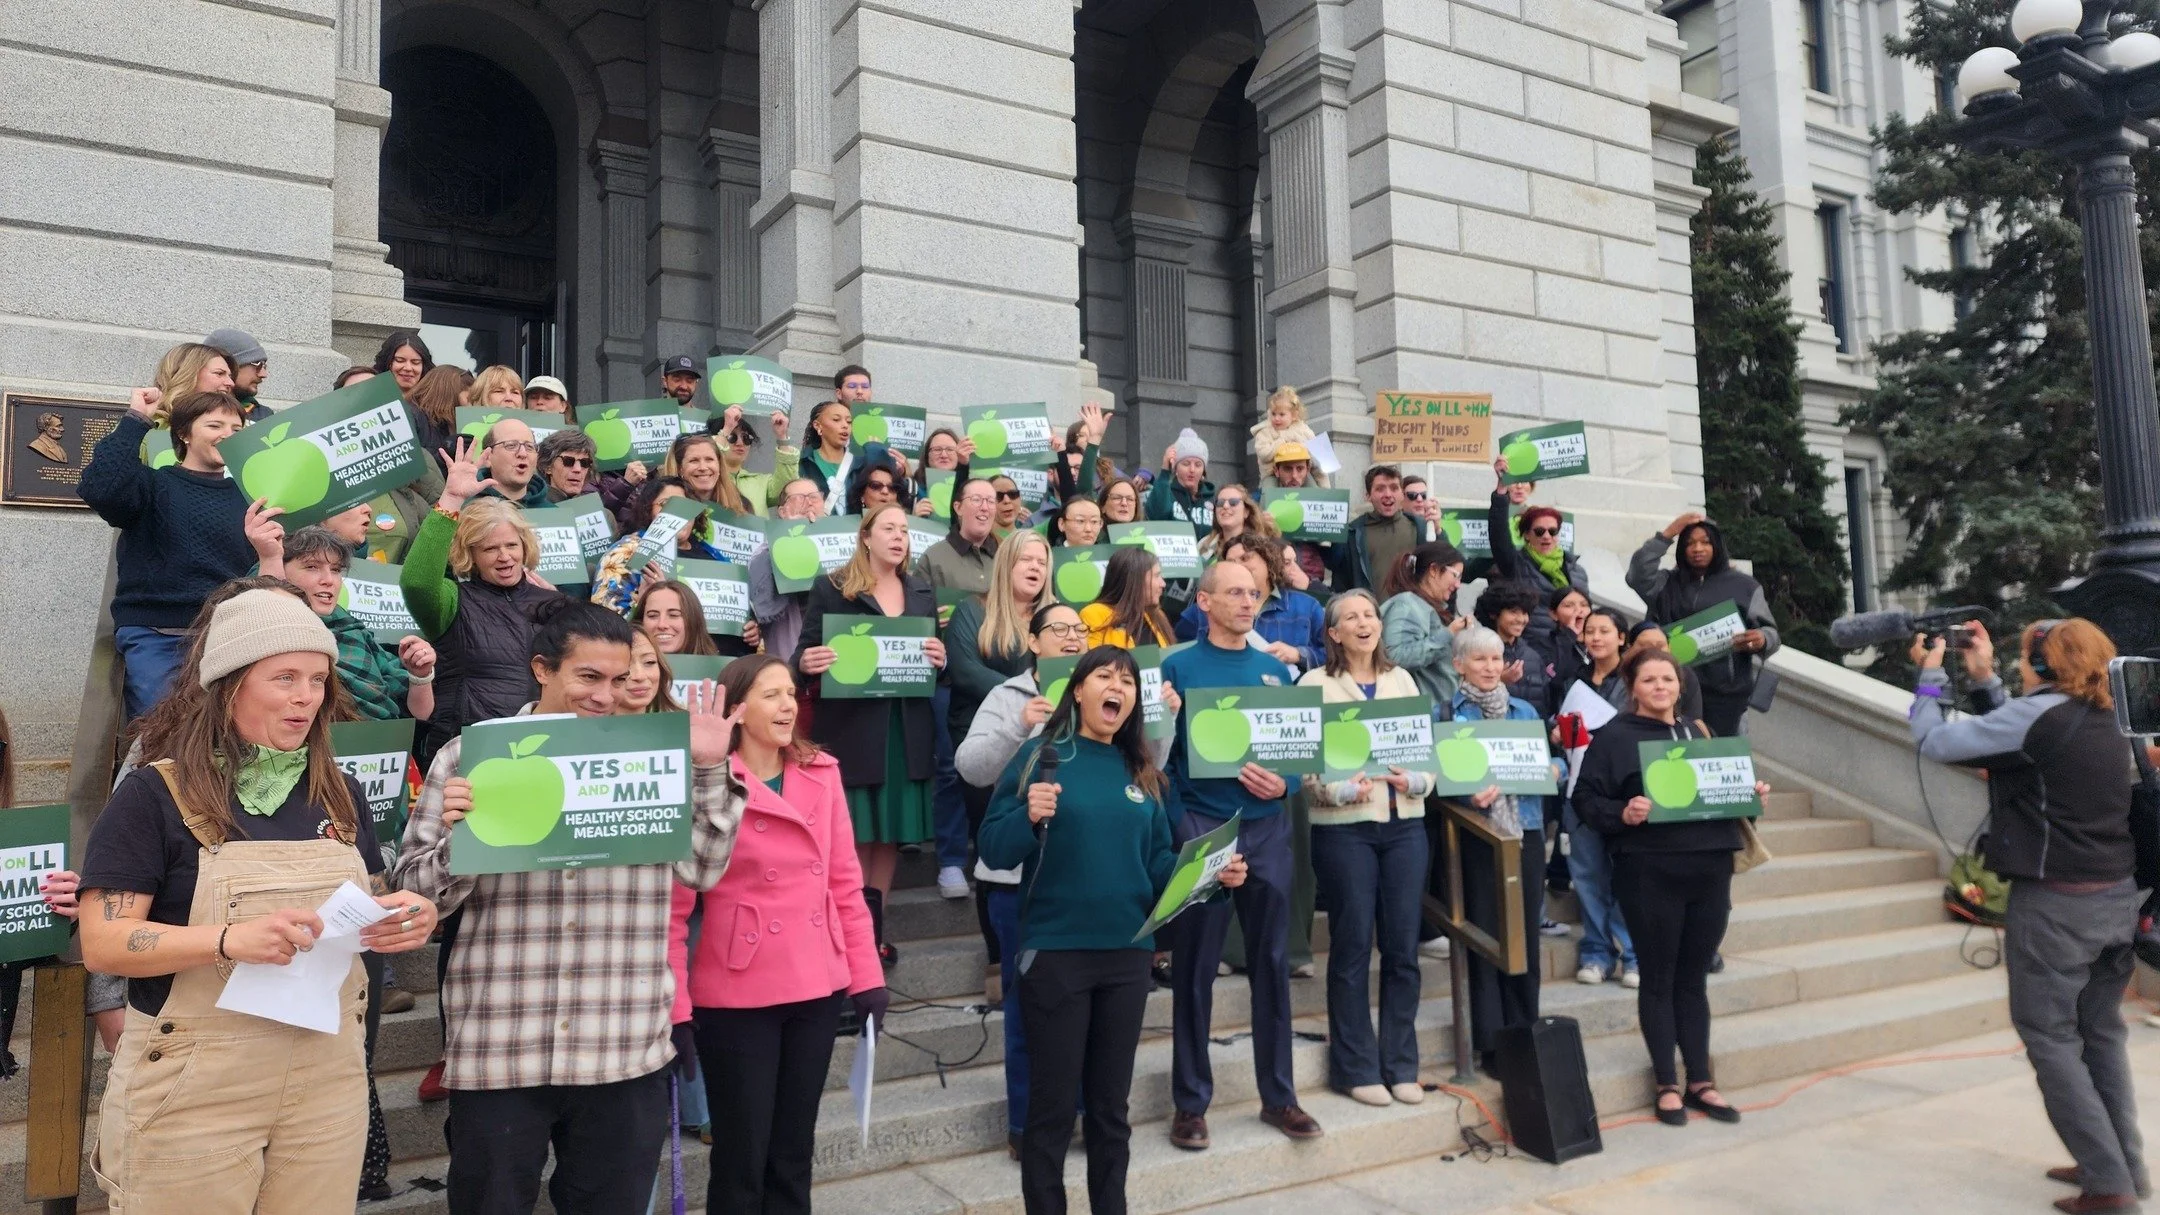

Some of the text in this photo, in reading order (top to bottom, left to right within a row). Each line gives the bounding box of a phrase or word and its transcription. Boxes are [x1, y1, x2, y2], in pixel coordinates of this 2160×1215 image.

[755, 373, 774, 384] YES
[1385, 393, 1422, 416] YES
[1426, 401, 1441, 416] ON
[1445, 400, 1462, 416] LL
[319, 408, 401, 446] YES ON LL
[632, 418, 675, 429] YES LL
[890, 420, 906, 428] YES
[1006, 421, 1026, 430] YES
[1378, 418, 1469, 436] BRIGHT MINDS
[652, 429, 670, 438] MM
[1025, 430, 1042, 438] MM
[336, 429, 396, 457] AND MM
[1375, 440, 1398, 454] NEED
[1403, 438, 1428, 453] FULL
[1541, 440, 1559, 448] YES
[334, 442, 414, 481] HEALTHY SCHOOL
[344, 454, 412, 488] MEALS FOR ALL
[586, 515, 602, 526] LL
[558, 530, 573, 540] LL
[718, 526, 760, 543] YES LL
[585, 538, 611, 551] SCHOOL
[818, 536, 839, 546] YES
[733, 542, 752, 552] MM
[585, 550, 597, 558] FOR
[352, 582, 383, 597] YES
[695, 581, 744, 594] YES LL
[718, 594, 738, 605] MM
[350, 611, 386, 622] HEALTHY
[364, 621, 384, 630] EALS
[882, 641, 906, 651] YES
[901, 654, 922, 664] MM
[1146, 672, 1158, 684] LL
[1255, 713, 1283, 724] YES
[1300, 712, 1316, 723] LL
[1373, 722, 1398, 733] YES
[1413, 719, 1426, 729] LL
[1280, 727, 1306, 738] MM
[1396, 733, 1419, 744] MM
[1252, 743, 1318, 752] HEALTHY SCHOOL
[1489, 742, 1542, 751] YES LL
[1258, 752, 1283, 760] MEALS
[1513, 754, 1536, 763] MM
[361, 763, 377, 773] ON
[379, 758, 399, 774] LL
[570, 756, 677, 780] YES ON LL
[1699, 761, 1749, 772] YES LL
[1721, 775, 1743, 784] MM
[578, 781, 660, 802] AND MM
[565, 807, 681, 826] HEALTHY SCHOOL
[574, 822, 673, 839] MEALS FOR ALL
[4, 850, 56, 870] ON LL
[0, 917, 52, 934] FOR ALL
[872, 1127, 933, 1152] ABOVE
